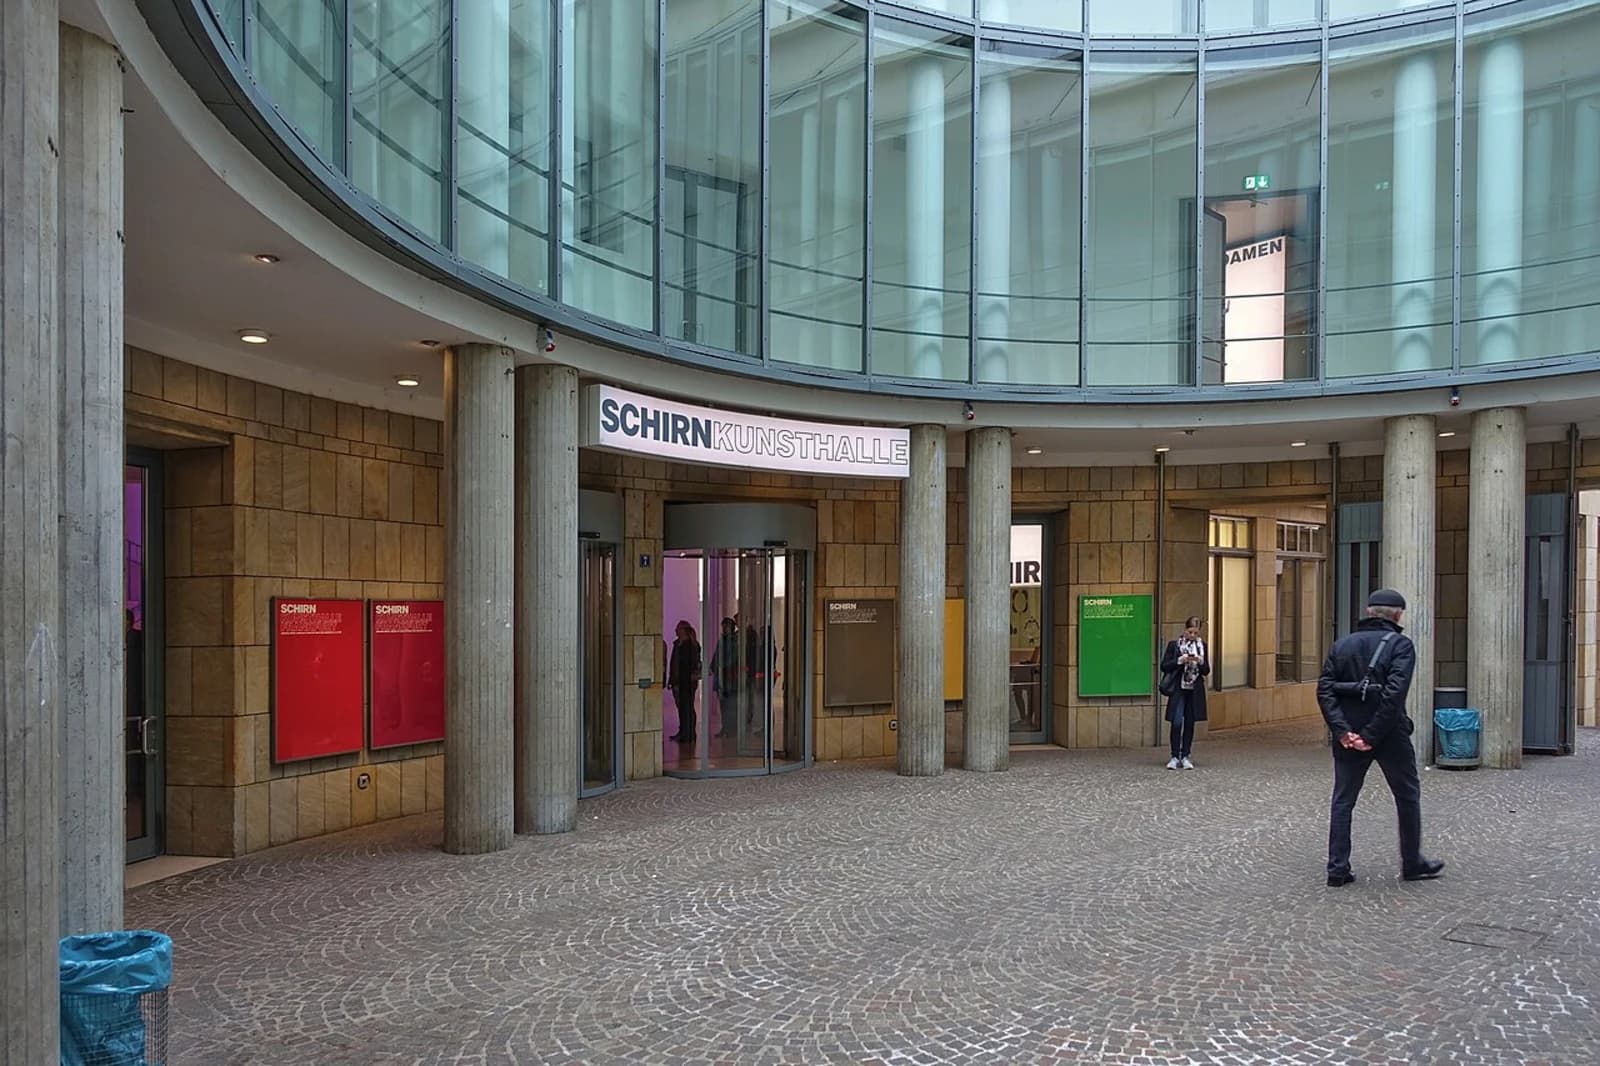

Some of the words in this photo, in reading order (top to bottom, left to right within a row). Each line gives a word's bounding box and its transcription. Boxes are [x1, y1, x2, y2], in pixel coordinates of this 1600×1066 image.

[1010, 560, 1041, 584] IR
[280, 604, 317, 614] SCHIRN
[375, 605, 409, 615] SCHIRN
